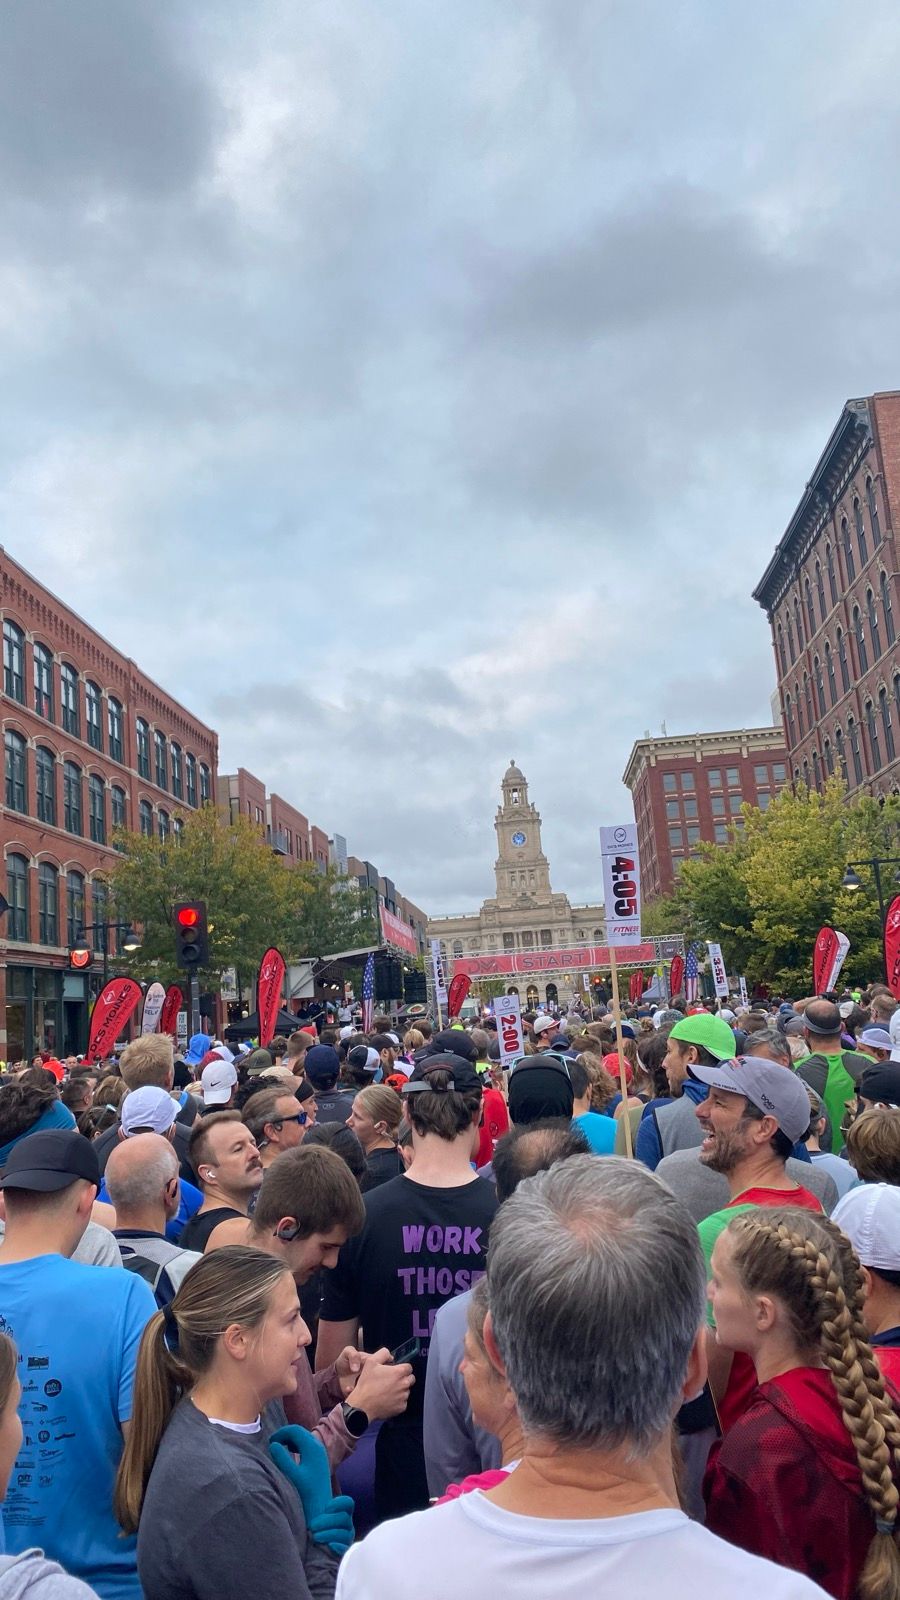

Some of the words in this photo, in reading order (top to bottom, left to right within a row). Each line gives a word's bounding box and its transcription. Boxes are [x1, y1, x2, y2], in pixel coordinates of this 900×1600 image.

[611, 856, 638, 917] 4:05
[522, 953, 585, 969] START
[713, 957, 725, 984] 3:55
[90, 1030, 106, 1052] DES
[105, 984, 132, 1028] MOINES
[500, 1014, 520, 1053] 2:00
[402, 1225, 483, 1255] WORK
